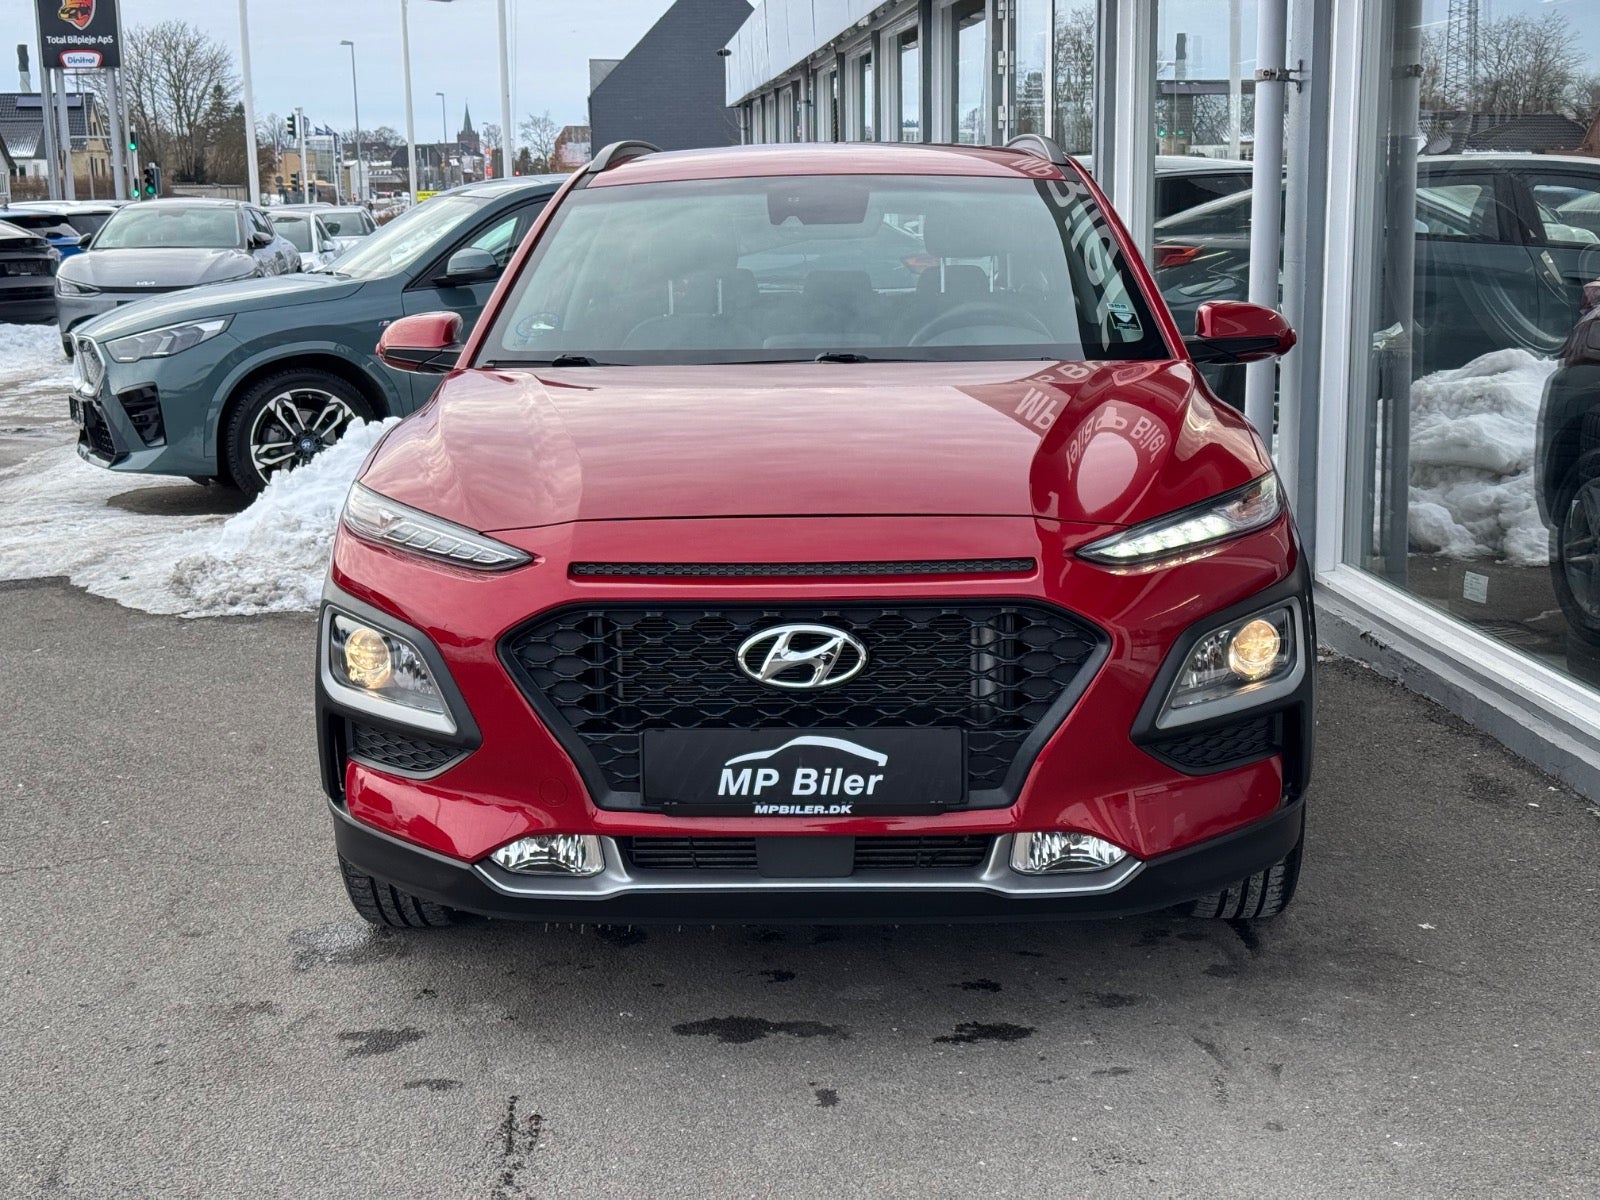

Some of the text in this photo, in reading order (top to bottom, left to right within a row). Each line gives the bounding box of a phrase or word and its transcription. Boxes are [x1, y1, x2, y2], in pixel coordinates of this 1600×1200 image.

[46, 35, 114, 45] Total Bilpleje ApS
[67, 56, 95, 64] Dinitrol
[717, 768, 884, 796] MP Biler
[754, 804, 853, 815] MPBILER.DK
